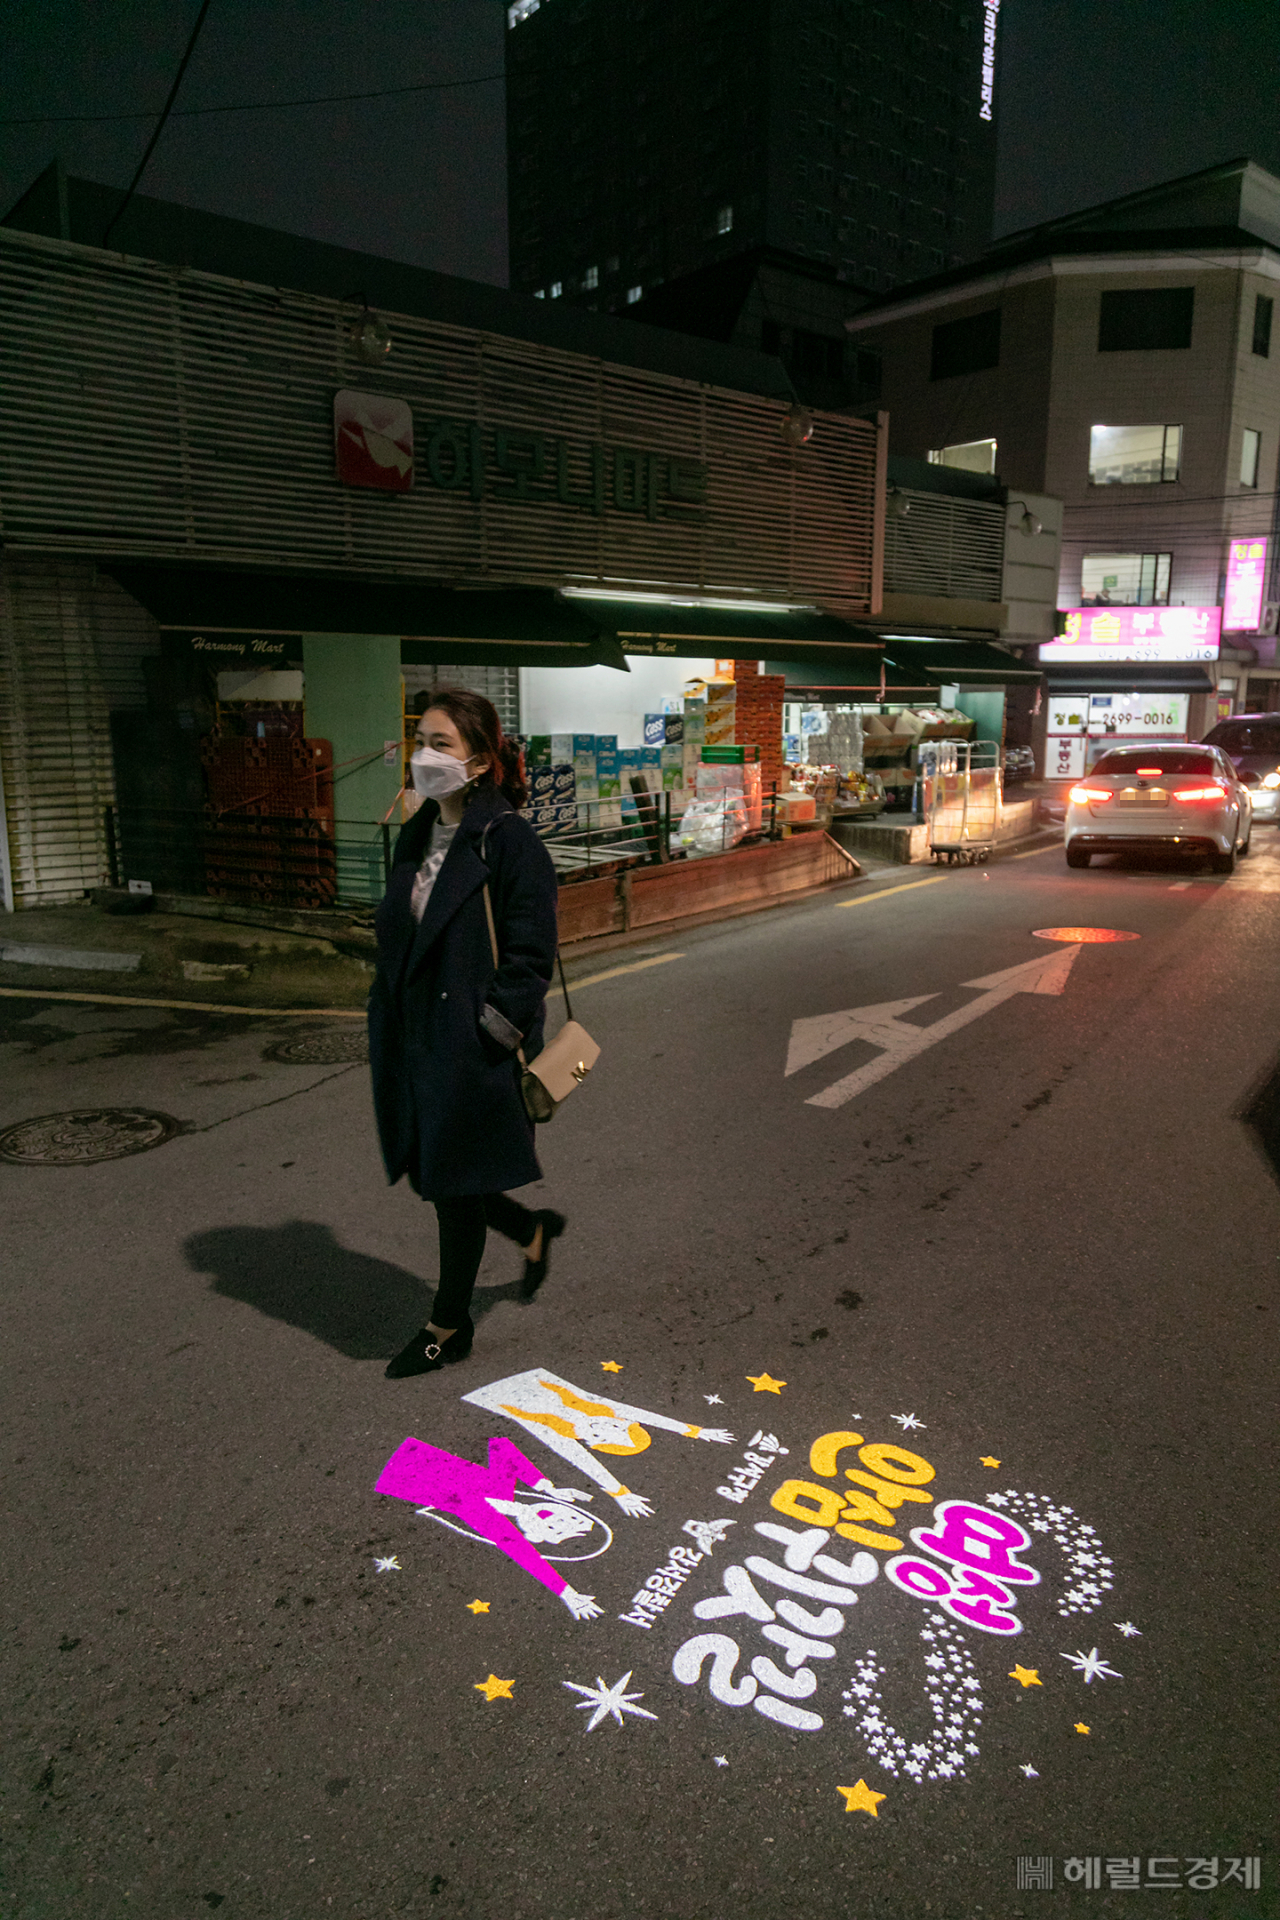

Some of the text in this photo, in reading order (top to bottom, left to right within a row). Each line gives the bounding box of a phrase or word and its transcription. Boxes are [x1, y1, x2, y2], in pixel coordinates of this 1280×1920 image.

[426, 418, 709, 521] 하모니마트
[191, 636, 285, 655] Harmony Mart
[1103, 712, 1174, 726] 2699-0016
[716, 1450, 776, 1504] 강서구청
[618, 1545, 704, 1629] 강서경찰서
[885, 1500, 1041, 1635] 여성
